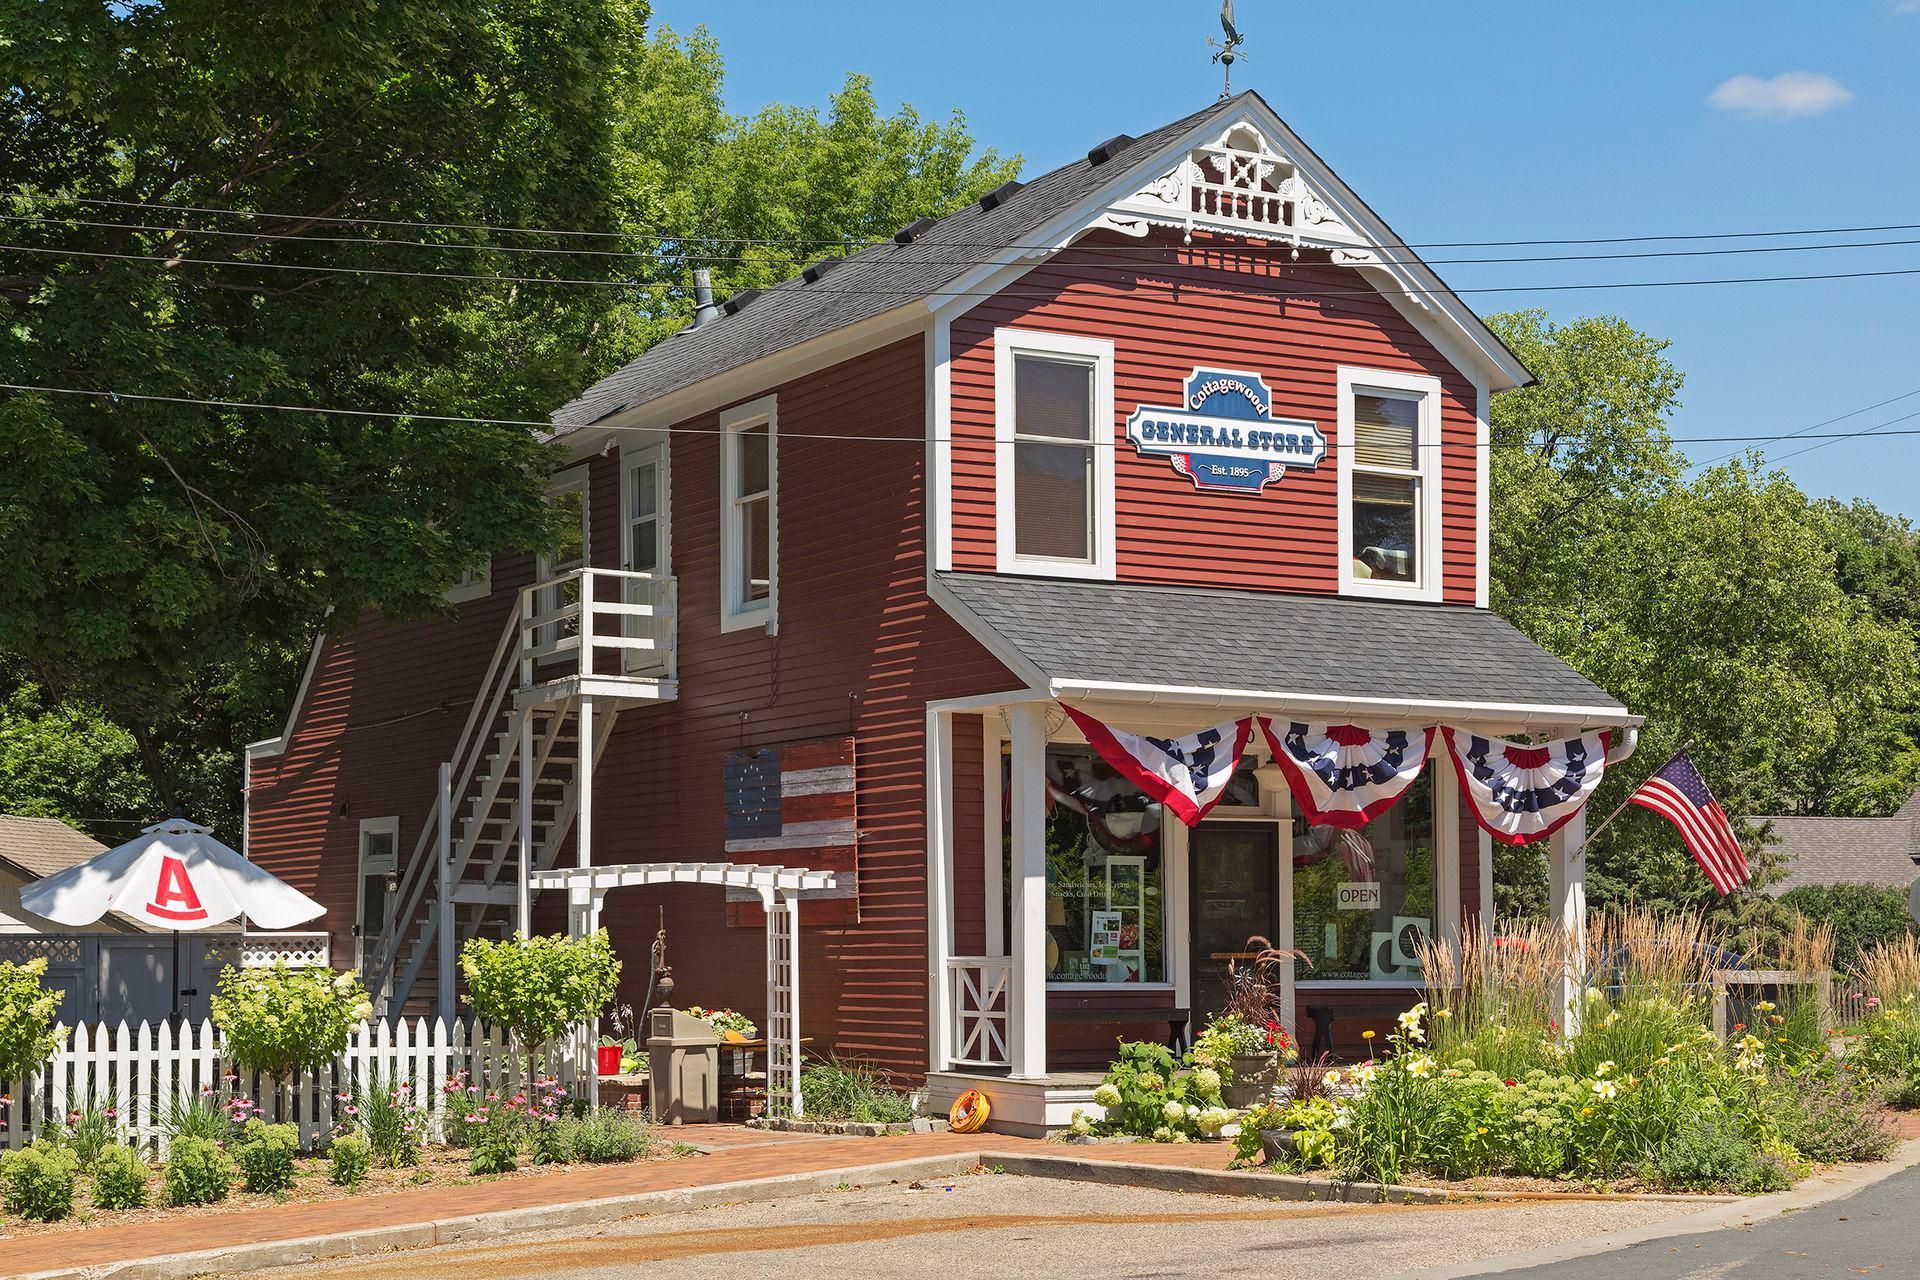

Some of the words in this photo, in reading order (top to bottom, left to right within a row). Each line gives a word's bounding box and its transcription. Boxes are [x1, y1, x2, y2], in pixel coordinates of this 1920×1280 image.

[1188, 378, 1269, 417] Cottagewood
[1141, 420, 1244, 449] GENERAL
[1247, 430, 1314, 456] STORE
[1211, 464, 1228, 477] Est.
[1229, 466, 1250, 478] 1895
[1340, 889, 1378, 903] OPEN
